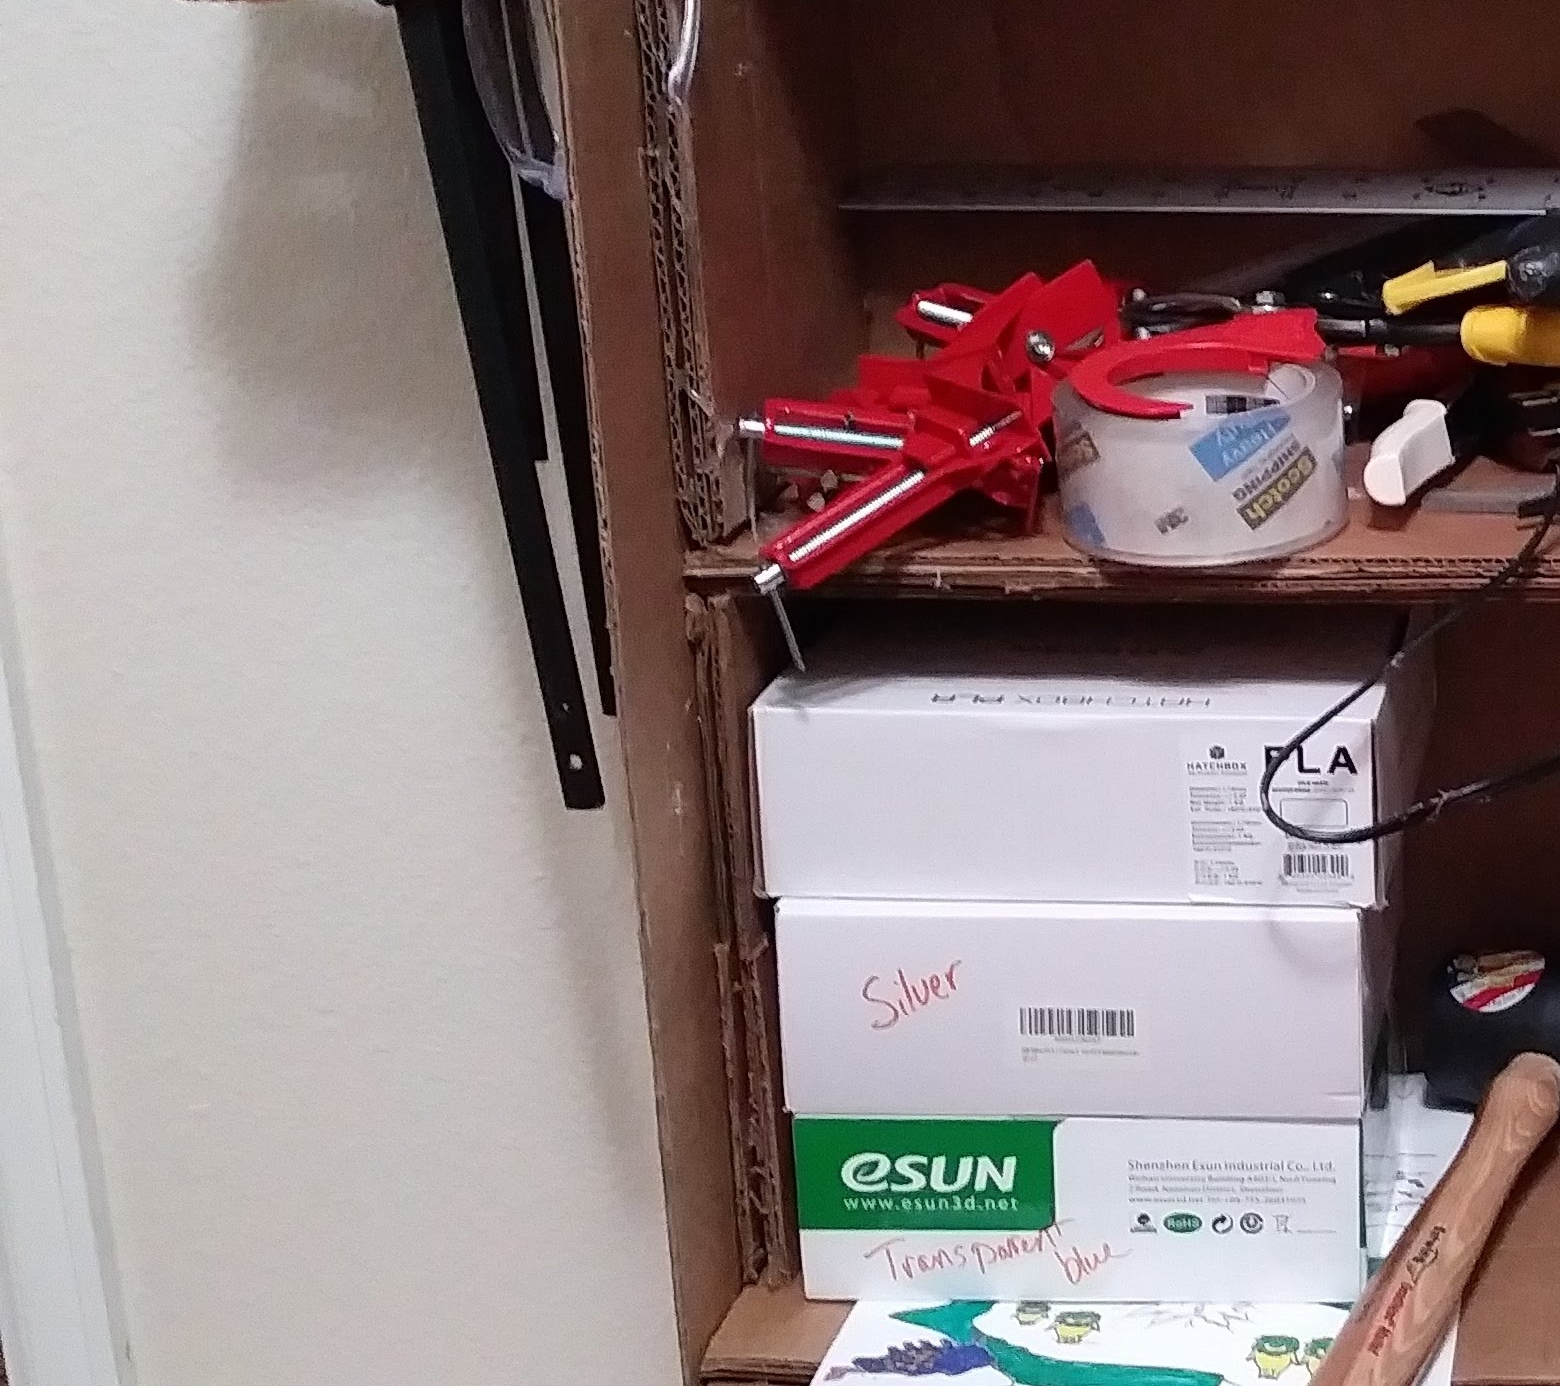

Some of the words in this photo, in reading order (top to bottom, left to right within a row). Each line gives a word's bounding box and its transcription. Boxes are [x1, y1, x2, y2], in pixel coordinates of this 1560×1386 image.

[1243, 449, 1316, 522] Scotch
[861, 959, 962, 1031] Silver
[841, 1152, 1017, 1193] eSUN
[843, 1194, 1019, 1212] www.esun3d.net
